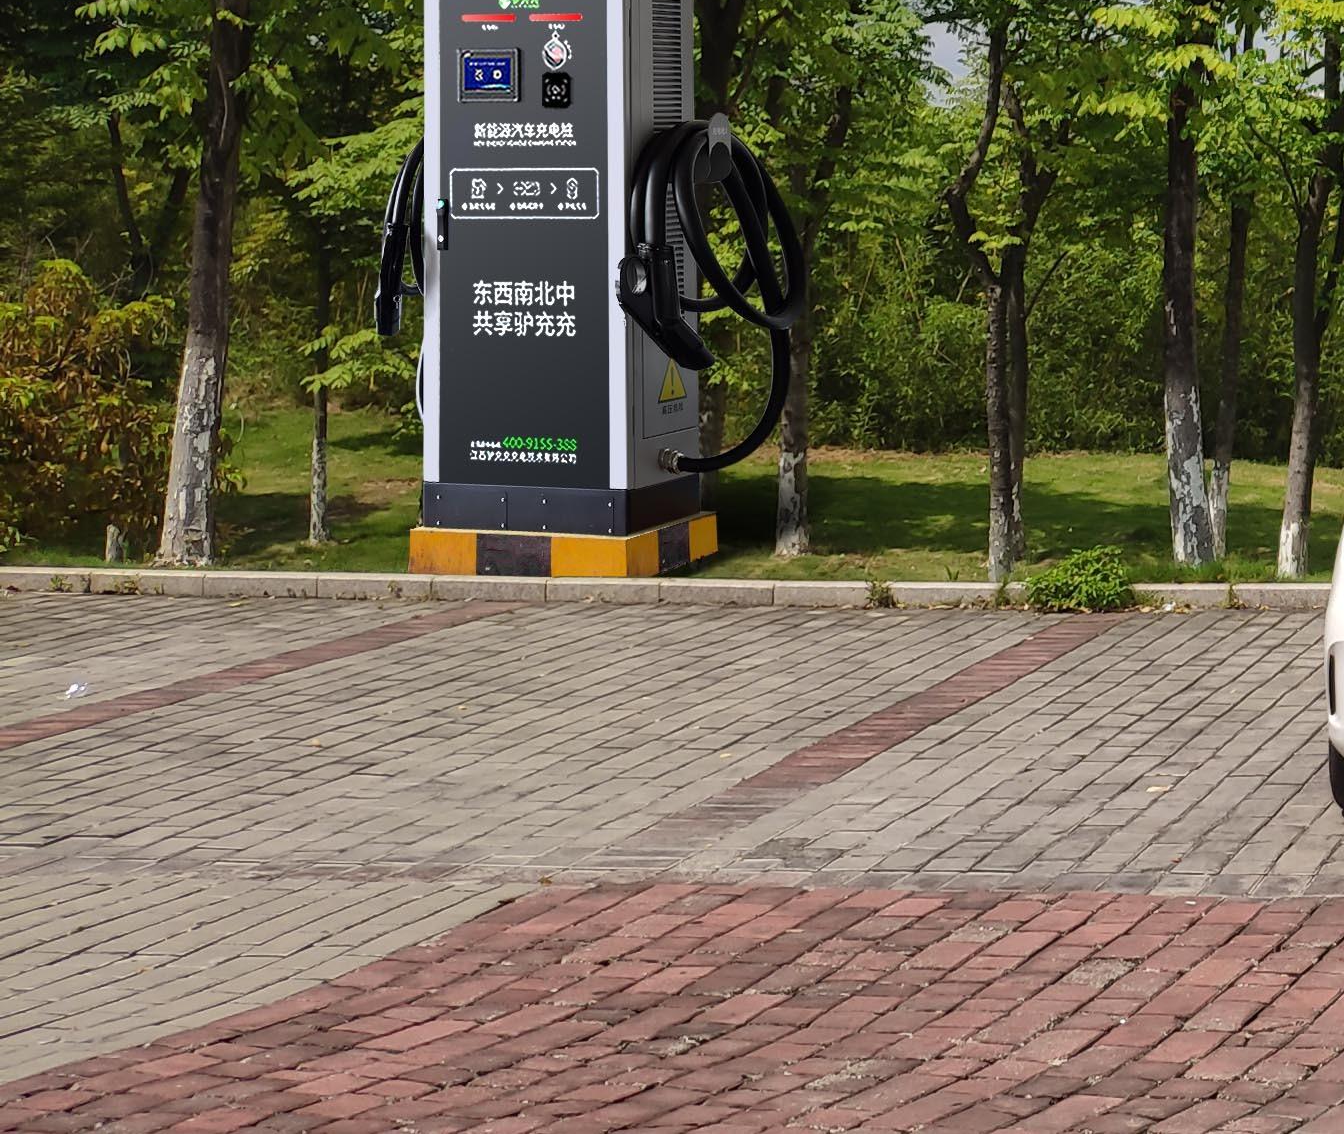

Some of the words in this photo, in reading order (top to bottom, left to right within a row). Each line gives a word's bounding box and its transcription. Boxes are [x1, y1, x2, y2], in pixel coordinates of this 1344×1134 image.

[472, 280, 576, 307] 东西南北中
[472, 311, 577, 337] 共享驴充充
